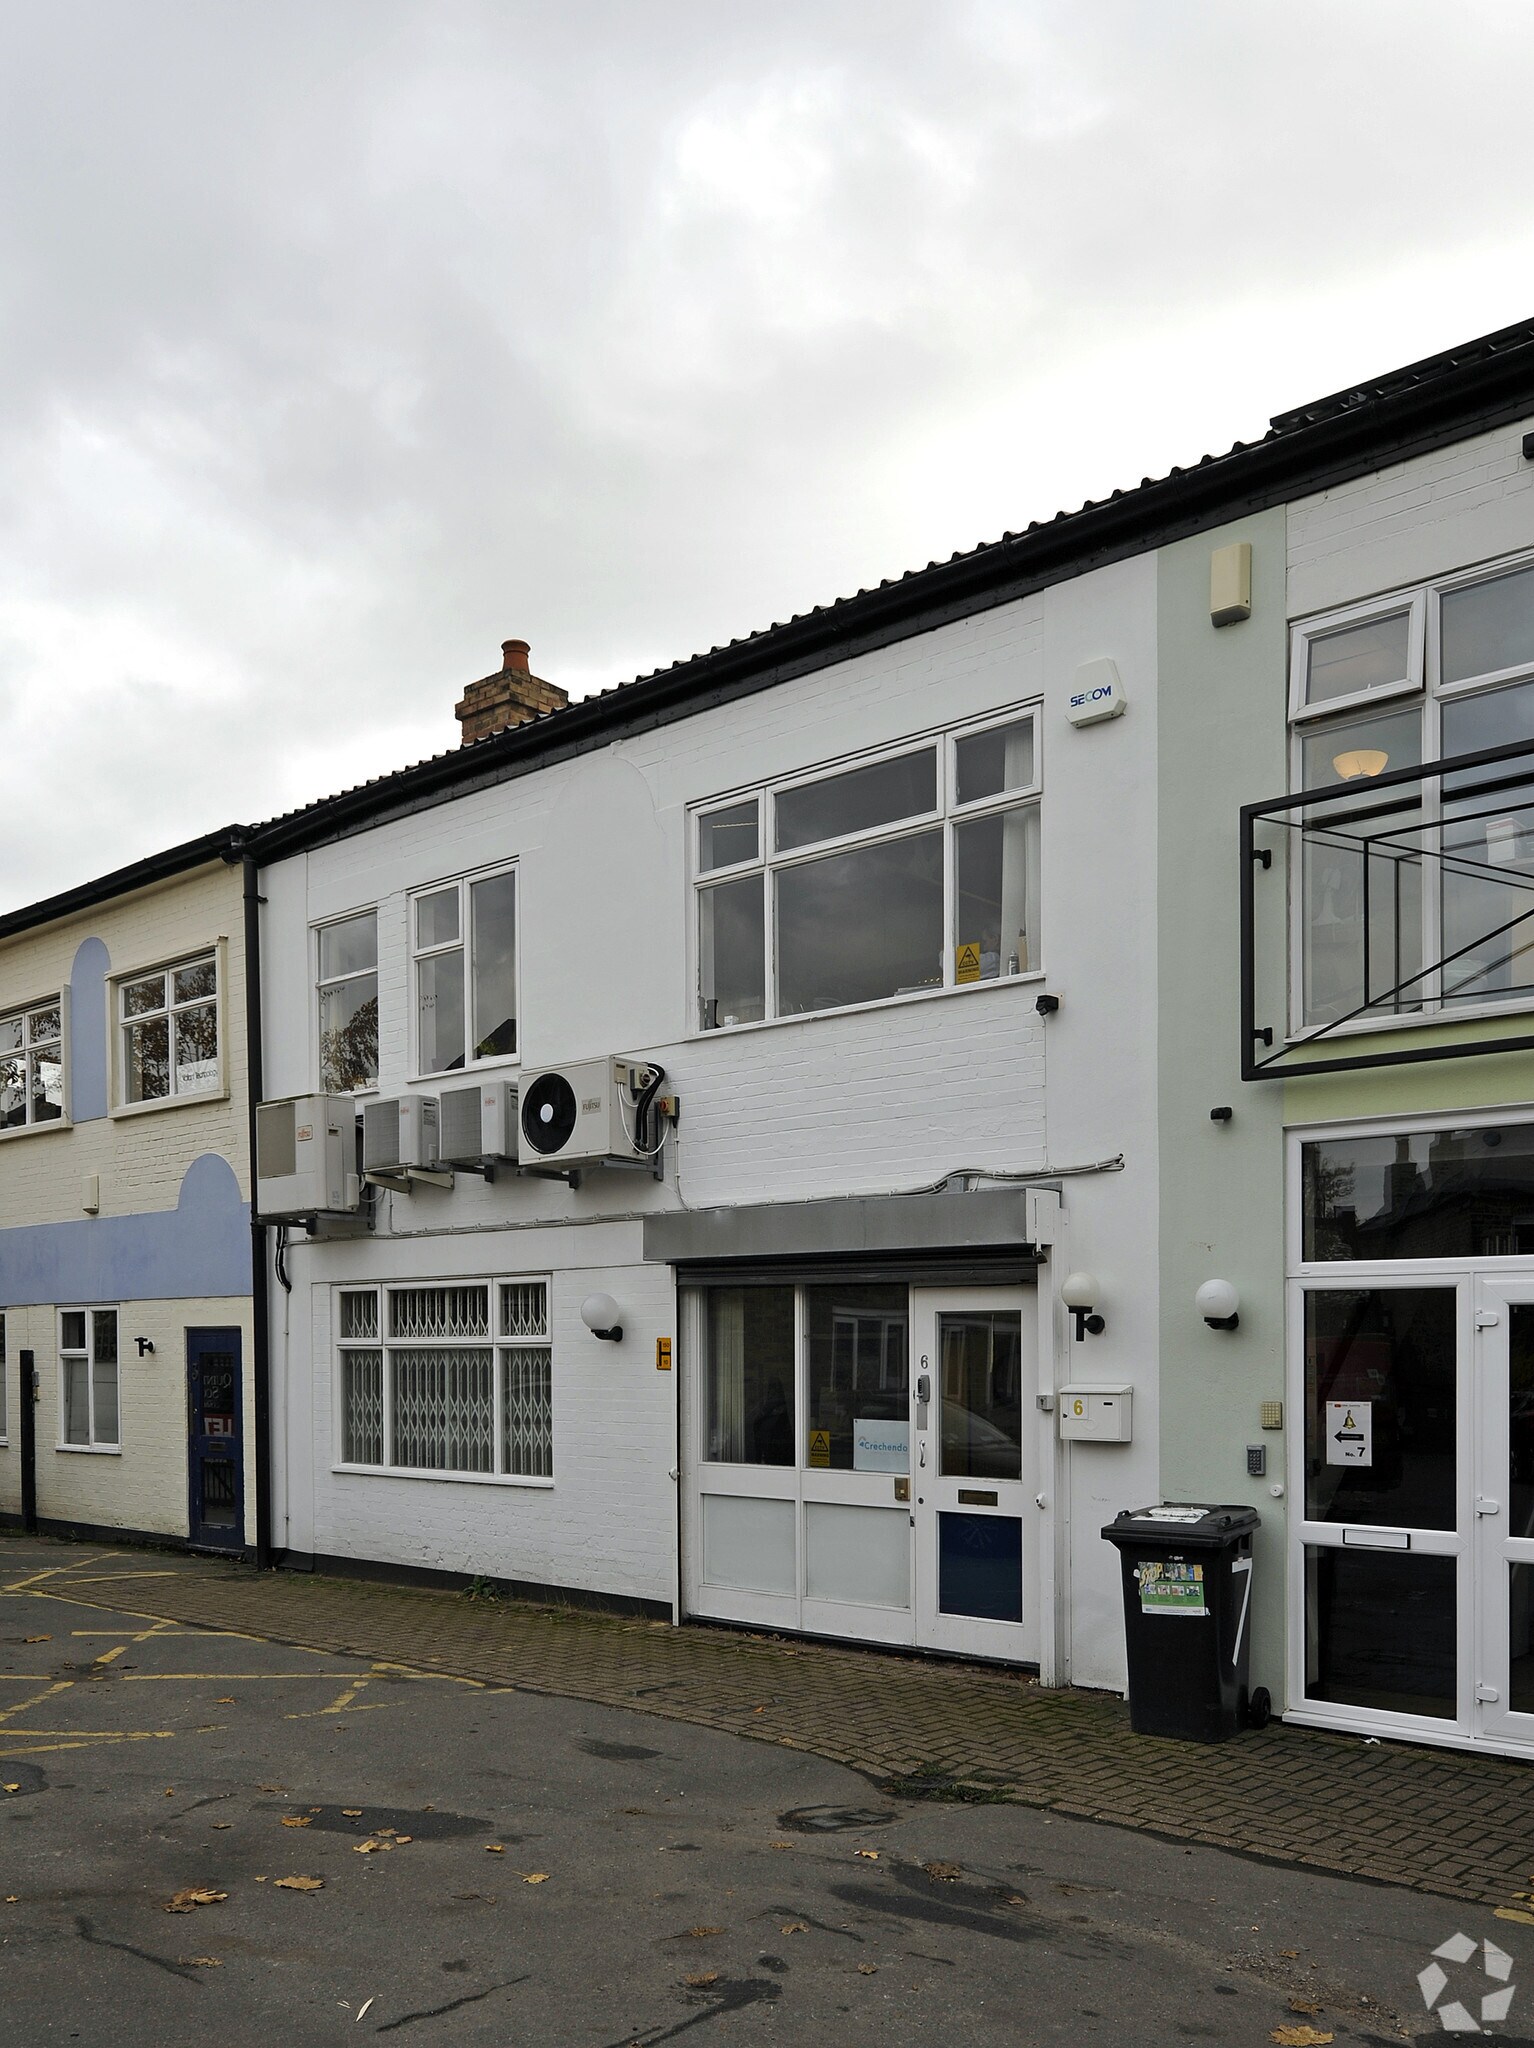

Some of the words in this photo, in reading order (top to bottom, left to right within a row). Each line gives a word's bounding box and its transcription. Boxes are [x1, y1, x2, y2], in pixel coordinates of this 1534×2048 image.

[1070, 685, 1112, 708] SECOM
[920, 1354, 929, 1369] 6
[1073, 1399, 1084, 1416] 6
[1357, 1446, 1366, 1457] 7
